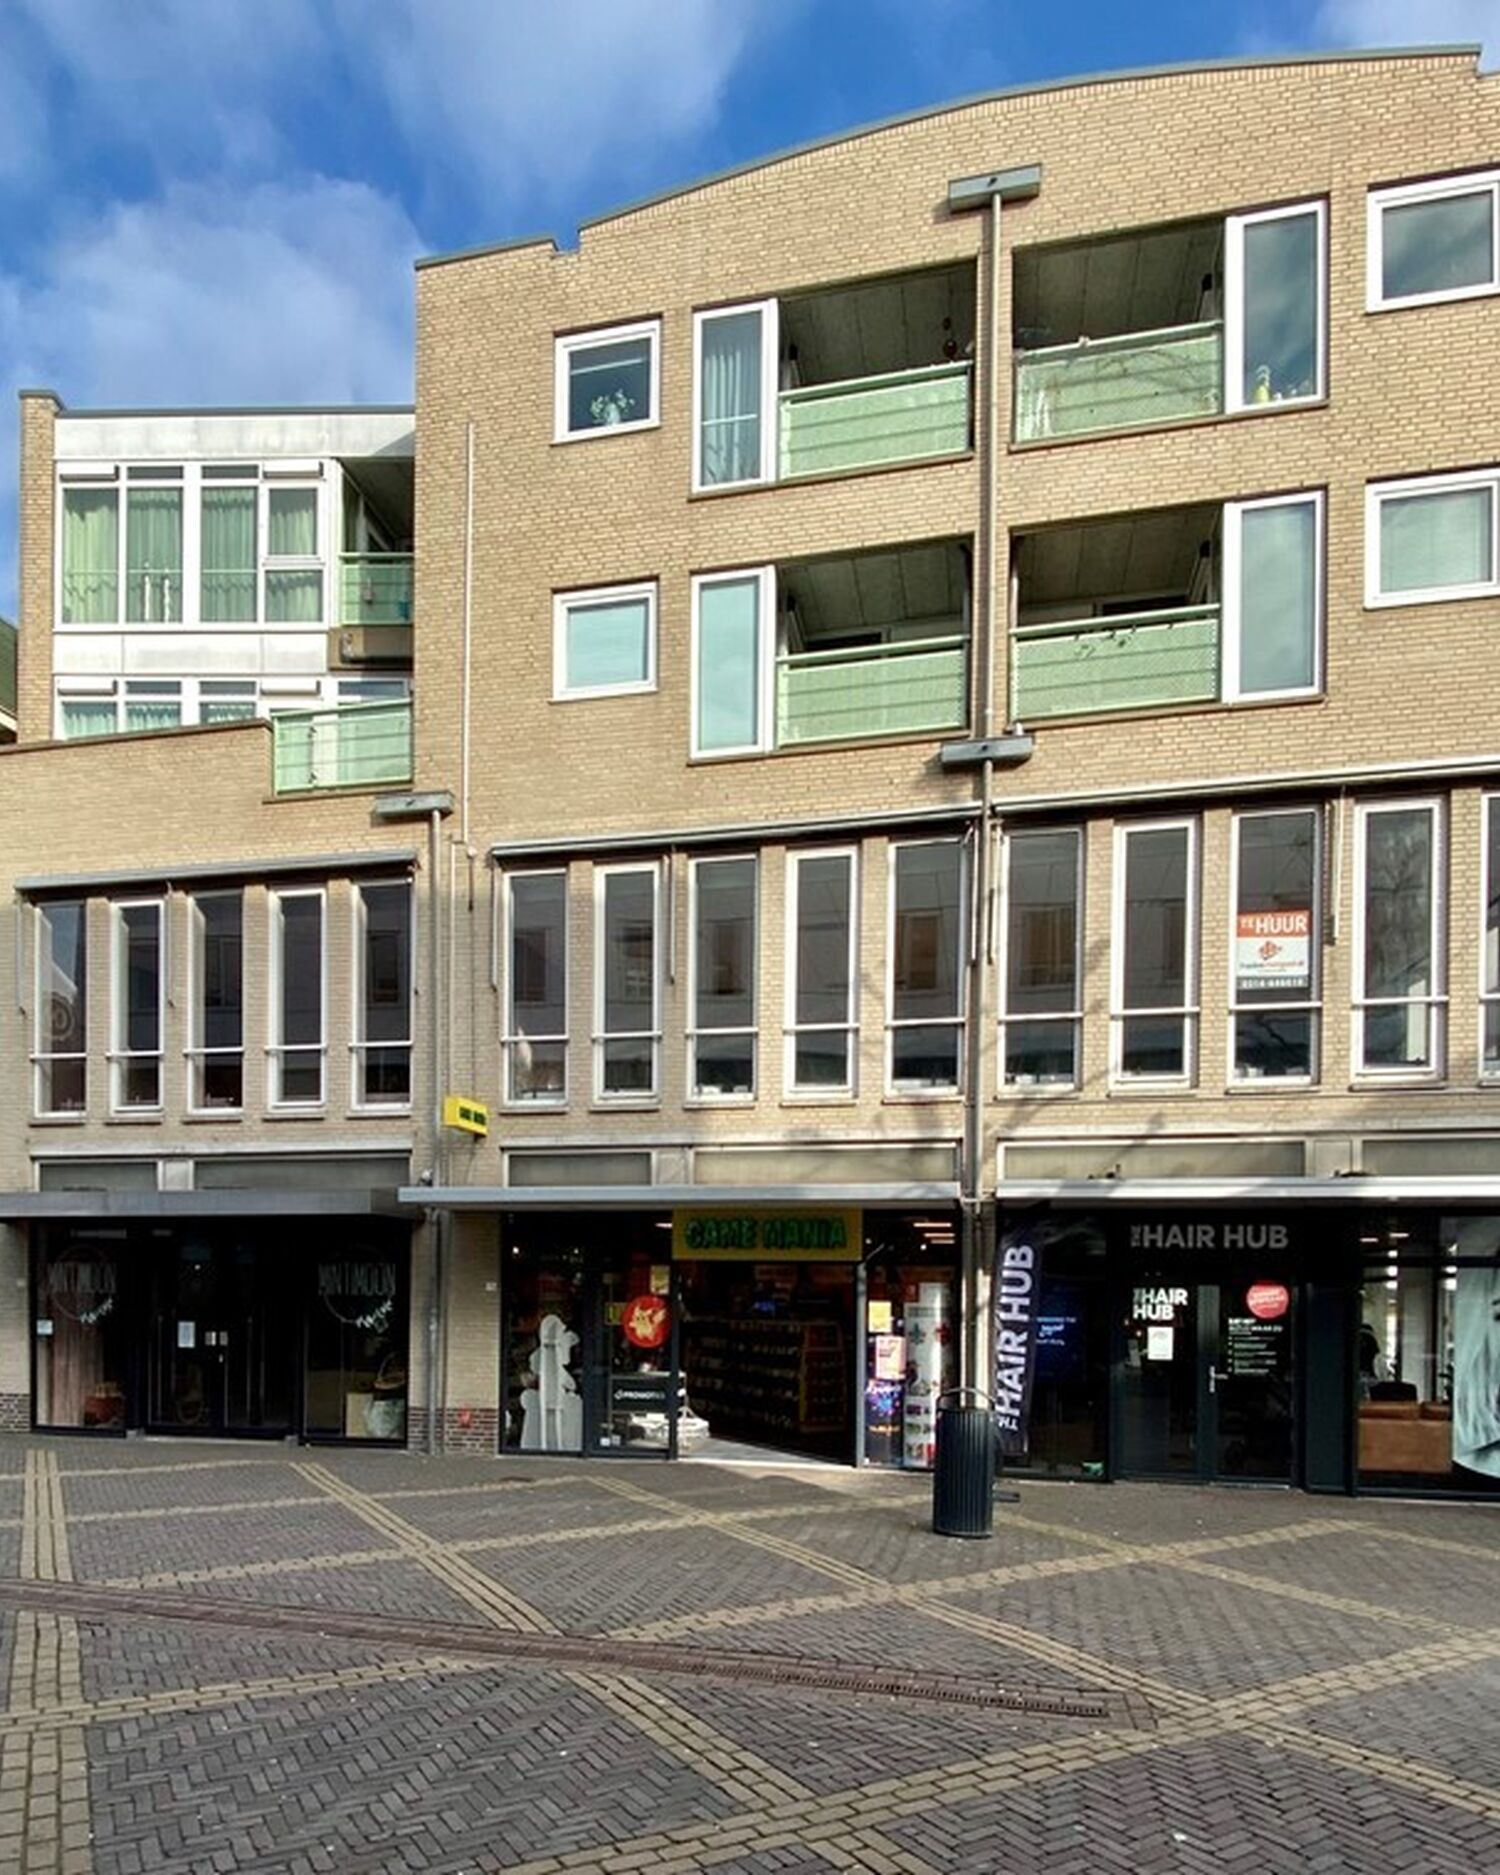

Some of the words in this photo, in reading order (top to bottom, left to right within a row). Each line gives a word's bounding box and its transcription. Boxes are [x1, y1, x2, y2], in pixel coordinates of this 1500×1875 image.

[1255, 914, 1308, 934] HUUR
[762, 1217, 848, 1249] MANIA
[1143, 1224, 1215, 1248] HAIR
[1223, 1224, 1289, 1249] HUB
[1000, 1245, 1035, 1322] HUB
[1142, 1287, 1188, 1305] HAIR
[1133, 1304, 1175, 1320] HUB
[995, 1328, 1029, 1418] HAIR
